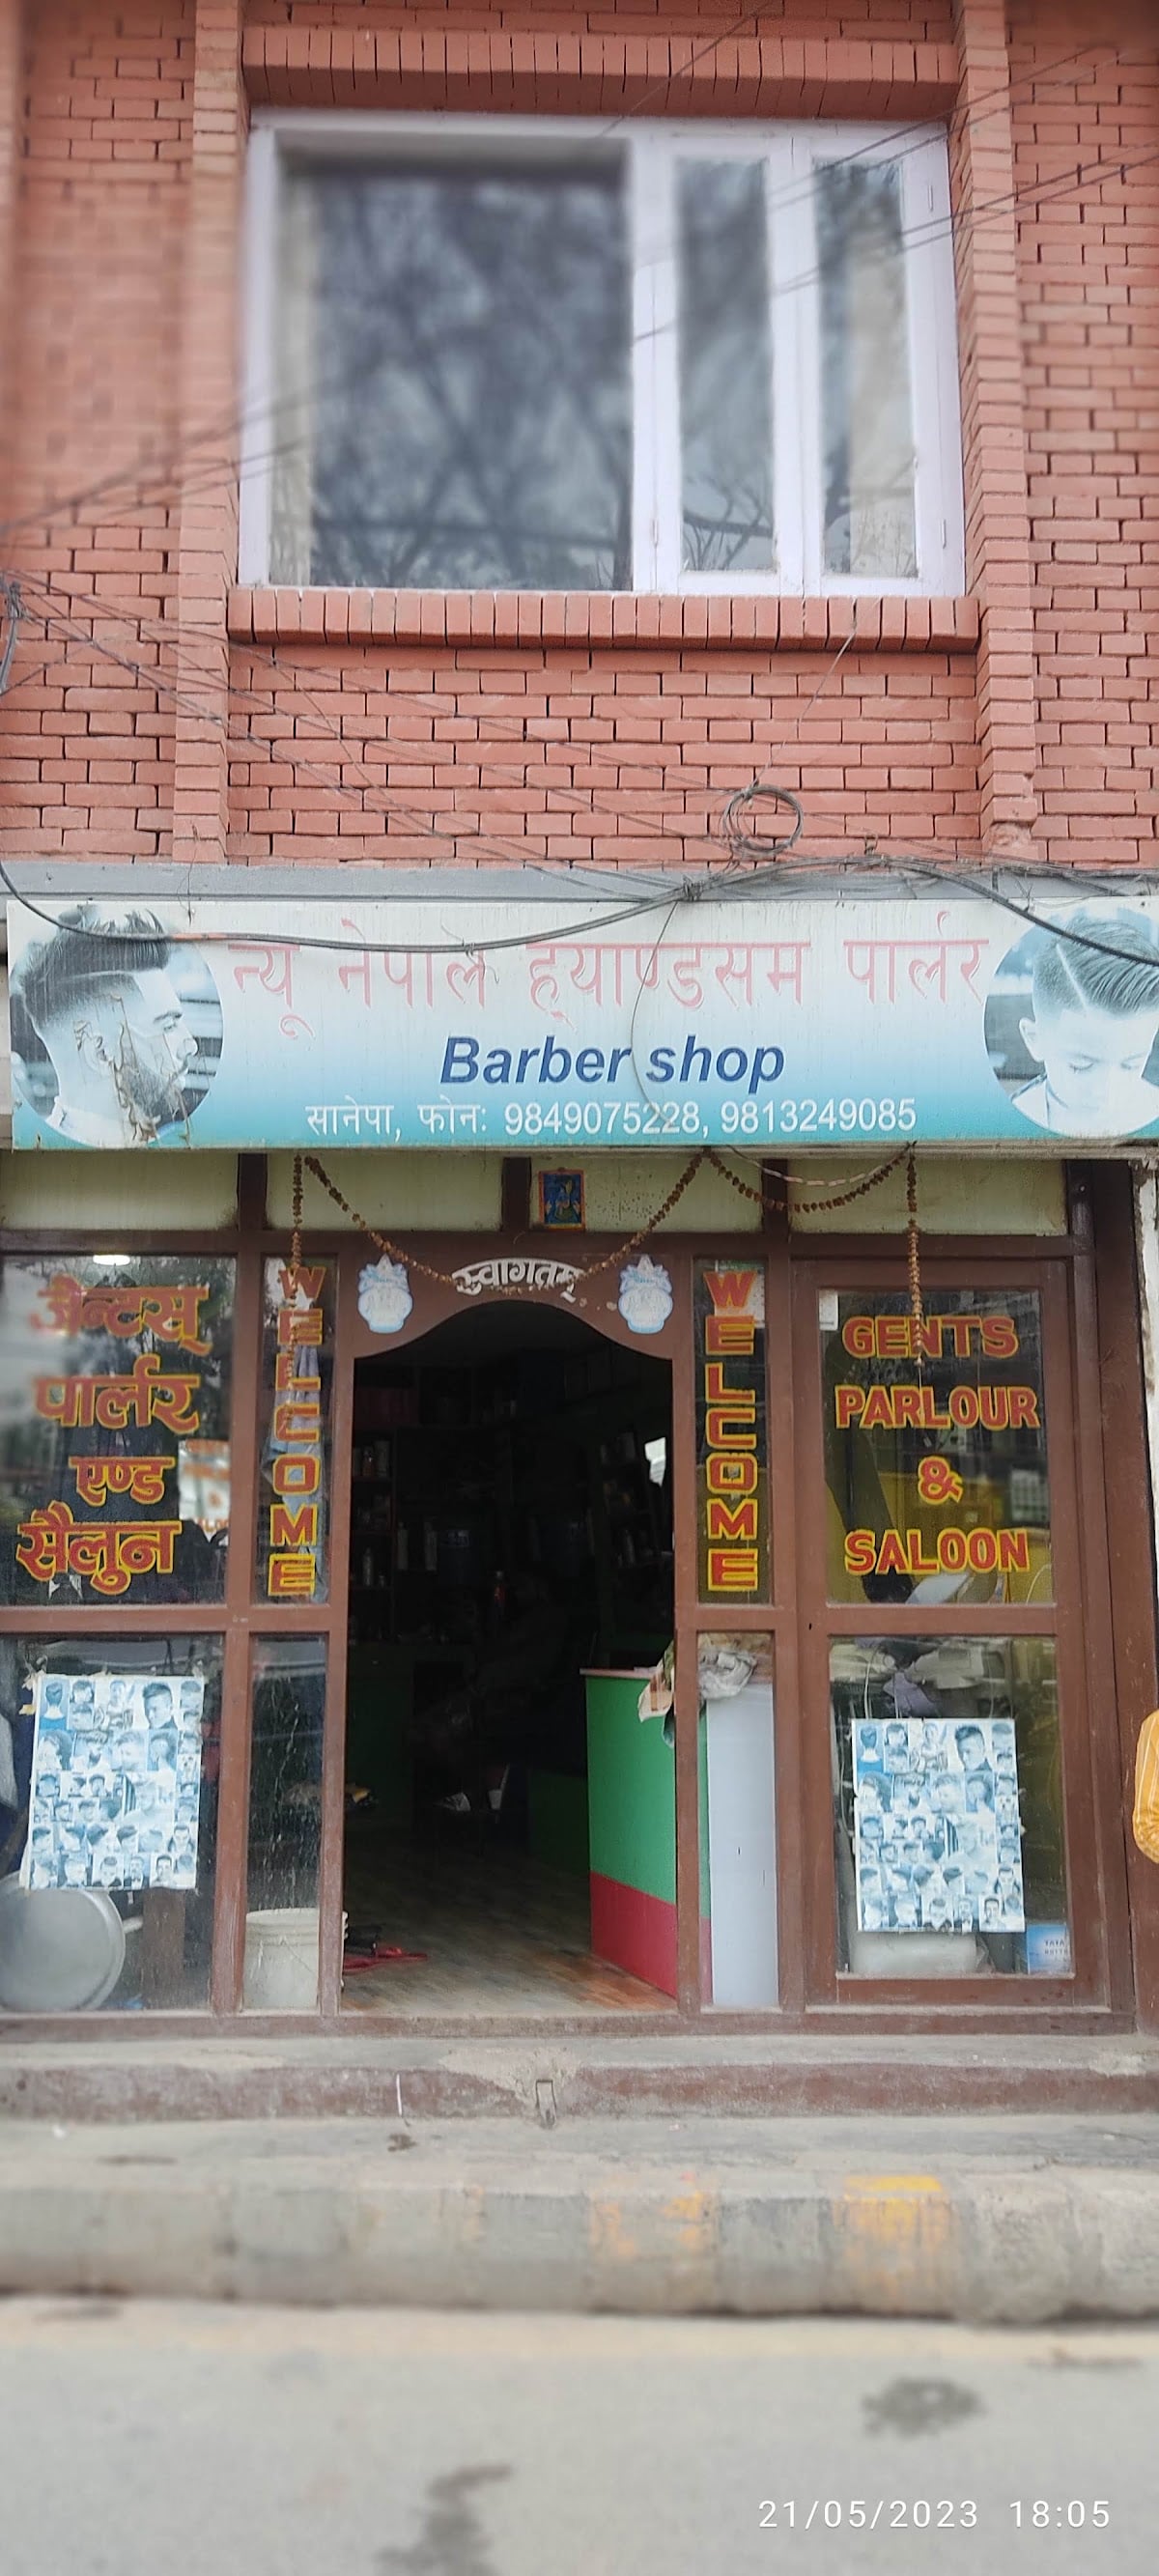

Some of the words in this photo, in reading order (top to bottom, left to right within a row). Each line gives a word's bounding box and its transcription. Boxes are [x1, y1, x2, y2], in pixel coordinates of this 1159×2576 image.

[227, 943, 316, 1039] न्यू
[337, 918, 488, 1009] नेपाल
[843, 911, 990, 1006] पार्लर
[439, 1034, 633, 1084] Barber
[645, 1034, 785, 1095] shop
[304, 1094, 402, 1143] सानेपा,
[503, 1100, 709, 1139] 9849075228,
[721, 1096, 918, 1133] 9813249085
[451, 1257, 585, 1304] स्वागतम्
[842, 1315, 1019, 1359] GENTS
[32, 1352, 201, 1435] पार्लर
[834, 1384, 1041, 1430] PARLOUR
[268, 1265, 326, 1597] WELCOME
[704, 1270, 759, 1592] WELCOME
[68, 1456, 176, 1506] एण्ड
[918, 1456, 964, 1505] &
[843, 1527, 1031, 1576] SALOON
